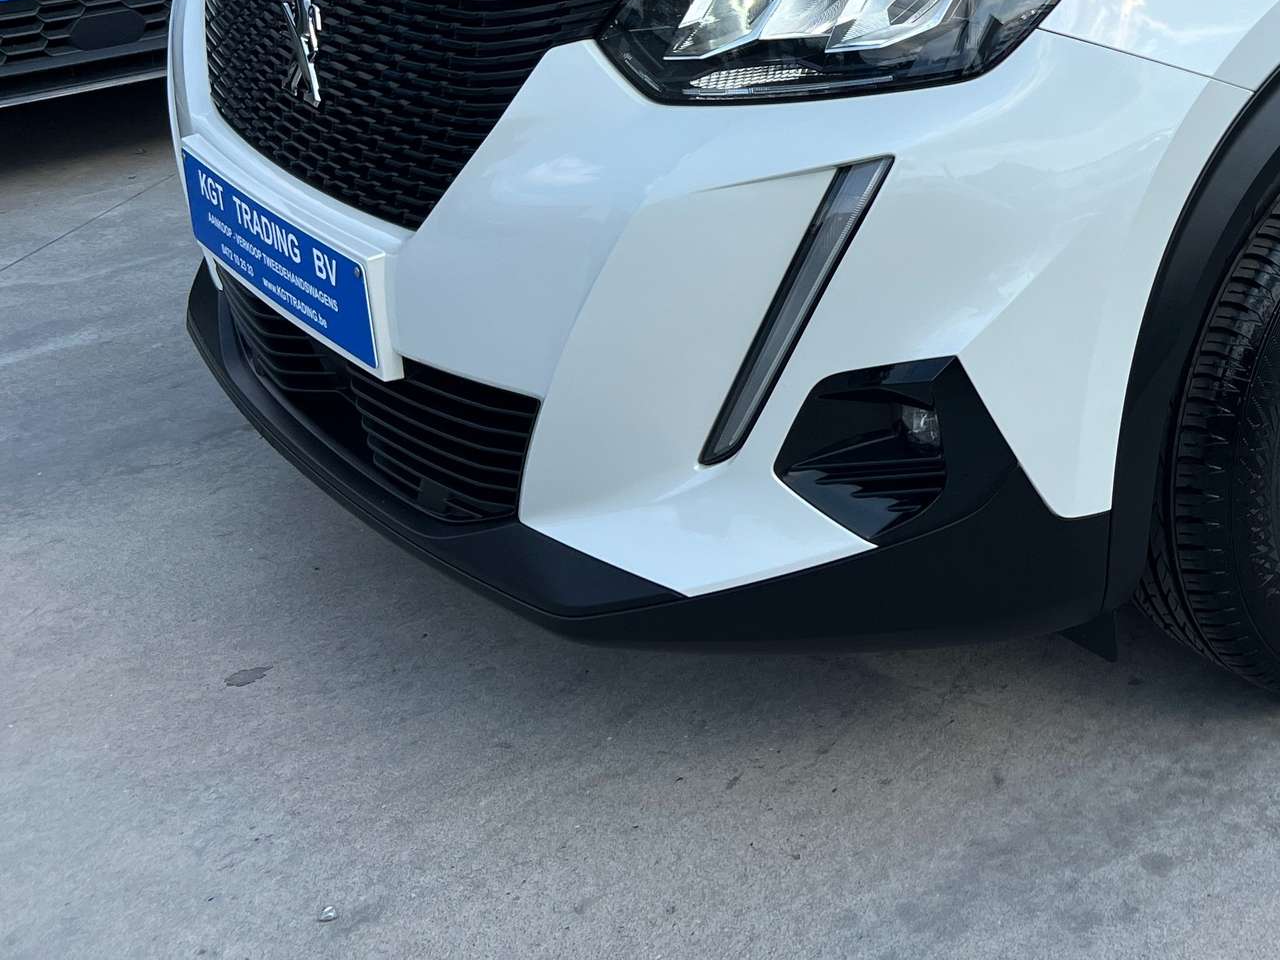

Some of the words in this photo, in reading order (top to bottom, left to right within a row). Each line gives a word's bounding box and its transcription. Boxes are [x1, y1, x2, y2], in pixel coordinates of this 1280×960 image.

[198, 169, 224, 211] KGT
[232, 195, 301, 264] TRADING
[312, 247, 336, 287] BV
[235, 232, 263, 262] VERKOOP
[262, 253, 339, 312] TWEEDEHANDSWAGENS
